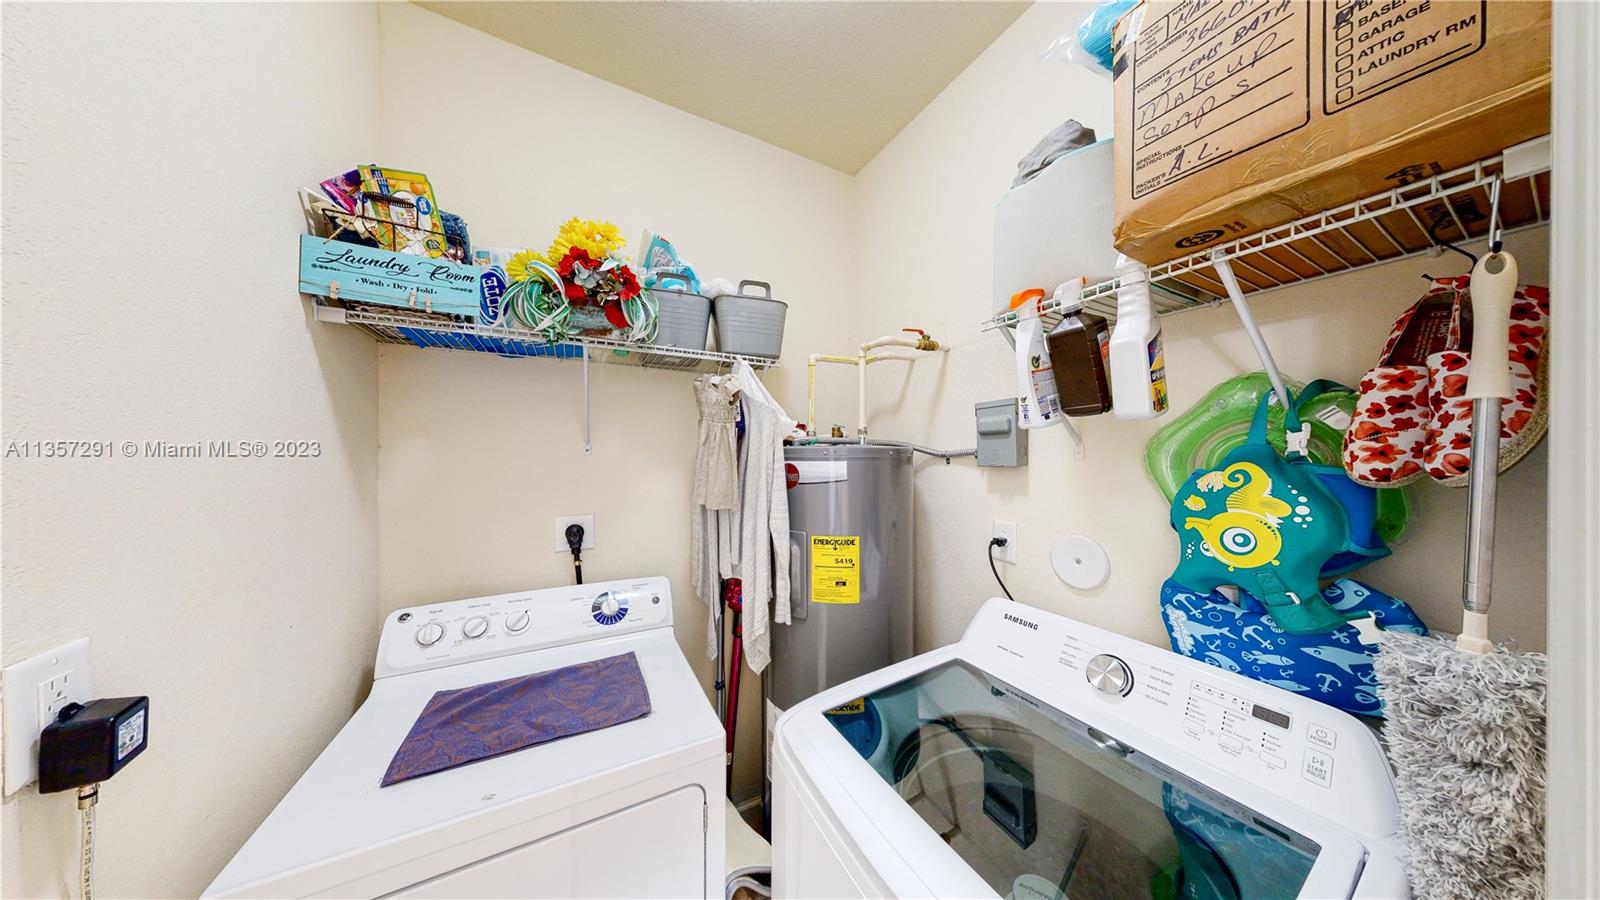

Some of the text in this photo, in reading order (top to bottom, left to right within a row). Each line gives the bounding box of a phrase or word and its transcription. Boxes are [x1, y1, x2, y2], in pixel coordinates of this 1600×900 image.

[1231, 0, 1293, 46] BATH
[1357, 0, 1431, 43] GARAGE
[1358, 0, 1407, 28] BASE
[1136, 30, 1189, 69] ORDER NUMBER
[1357, 14, 1477, 77] LAUNDRY RM
[1357, 30, 1406, 61] ATTIC
[1136, 69, 1171, 94] CONTENTS
[1135, 144, 1183, 172] INSTRUCTIONS
[1135, 150, 1162, 167] SPECIAL
[1135, 172, 1167, 190] PACKER'S
[1135, 180, 1162, 195] INITIALS
[315, 248, 477, 286] Laundry Room
[360, 277, 434, 296] Wash Dry Fold
[1003, 612, 1039, 631] SAMSUNG
[1309, 734, 1333, 747] POWER
[1306, 768, 1326, 781] PAUSE
[1307, 763, 1327, 775] START
